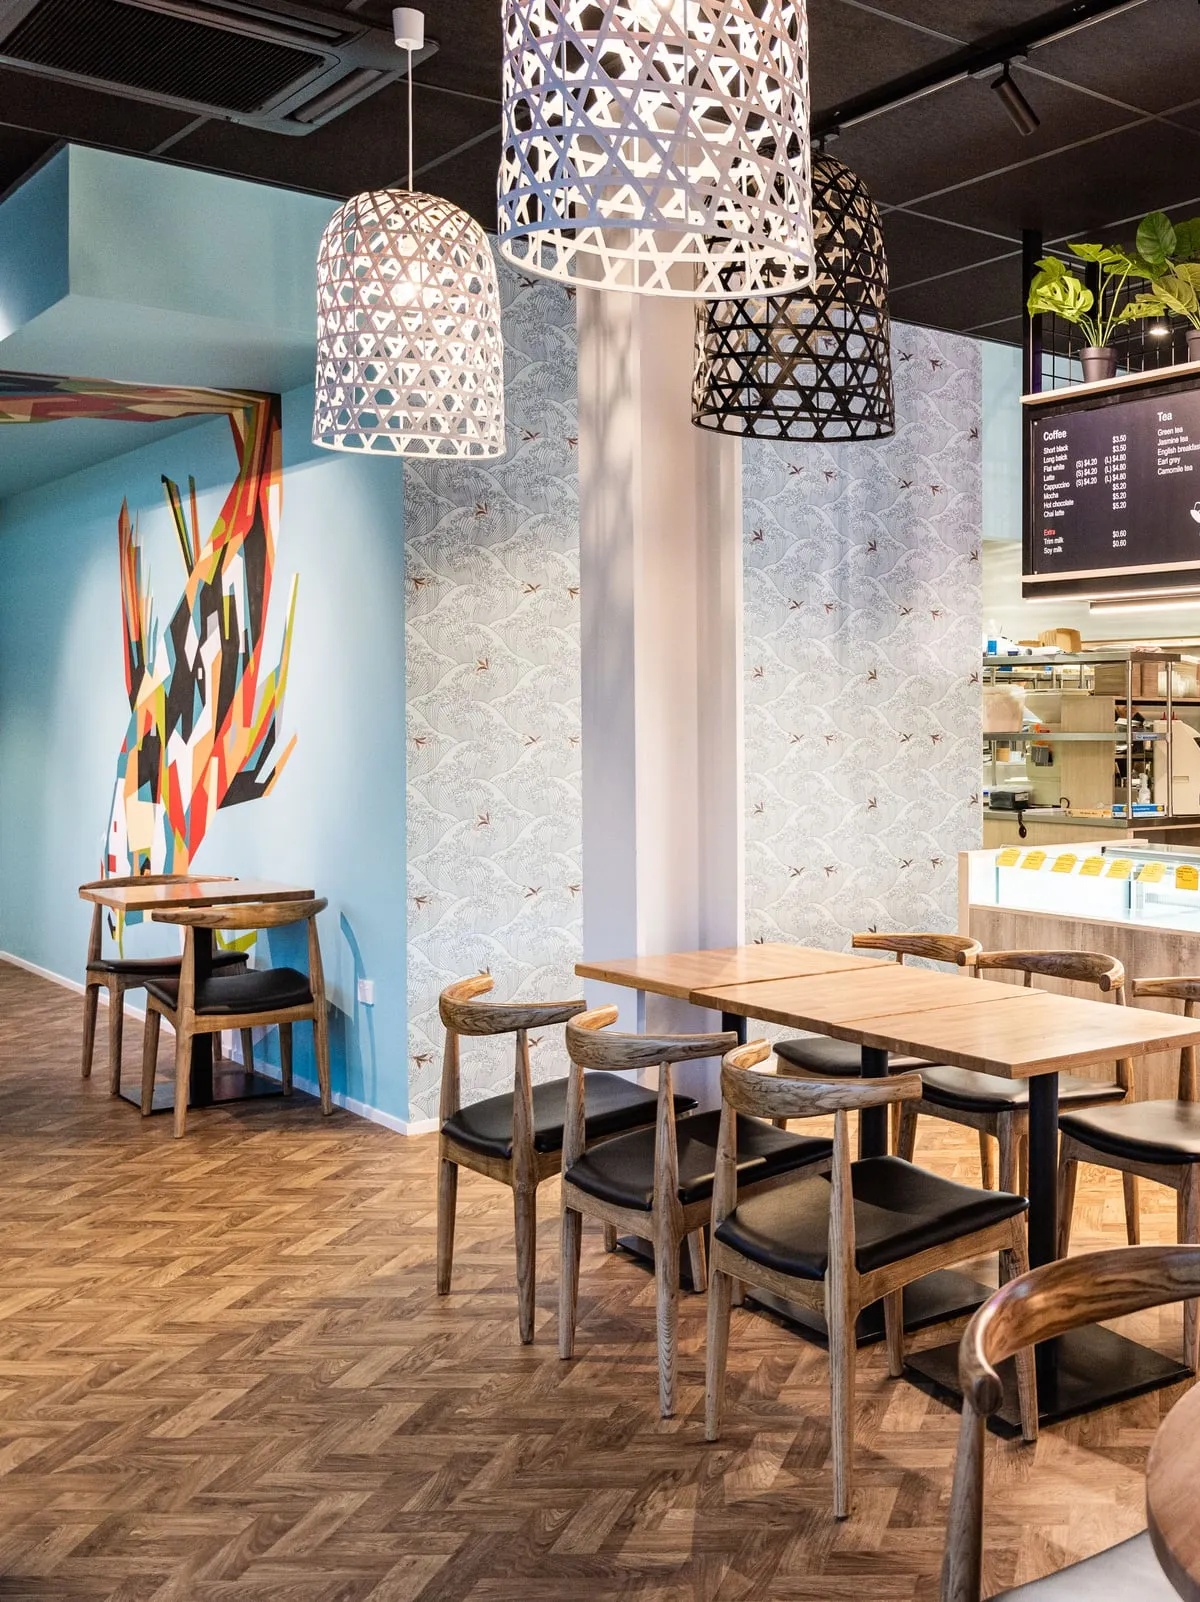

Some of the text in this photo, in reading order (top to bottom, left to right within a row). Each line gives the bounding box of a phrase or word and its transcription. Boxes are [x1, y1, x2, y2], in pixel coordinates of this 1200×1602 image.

[1157, 411, 1172, 422] Tea
[1043, 429, 1067, 441] Coffee
[1157, 428, 1174, 436] Green
[1043, 434, 1127, 454] Short black $3.50
[1157, 437, 1179, 446] Jasmine
[1043, 455, 1055, 464] Long
[1112, 444, 1127, 453] $3.50
[1157, 447, 1176, 456] English
[1053, 463, 1065, 471] white
[1084, 458, 1097, 467] $4.20
[1104, 456, 1112, 465] (L)
[1157, 457, 1168, 465] Earl
[1043, 474, 1055, 482] Latte
[1084, 467, 1097, 476] $4.20
[1104, 465, 1112, 474] (L)
[1157, 466, 1183, 475] Camomile
[1184, 464, 1193, 472] tea
[1043, 482, 1070, 491] Cappuccino
[1084, 477, 1097, 485] $4.20
[1104, 475, 1112, 484] (L)
[1112, 482, 1127, 491] $5.20
[1052, 499, 1074, 508] chocolate
[1112, 492, 1127, 500] $5.20
[1112, 501, 1127, 510] $5.20
[1054, 536, 1064, 544] milk
[1043, 547, 1052, 555] Soy
